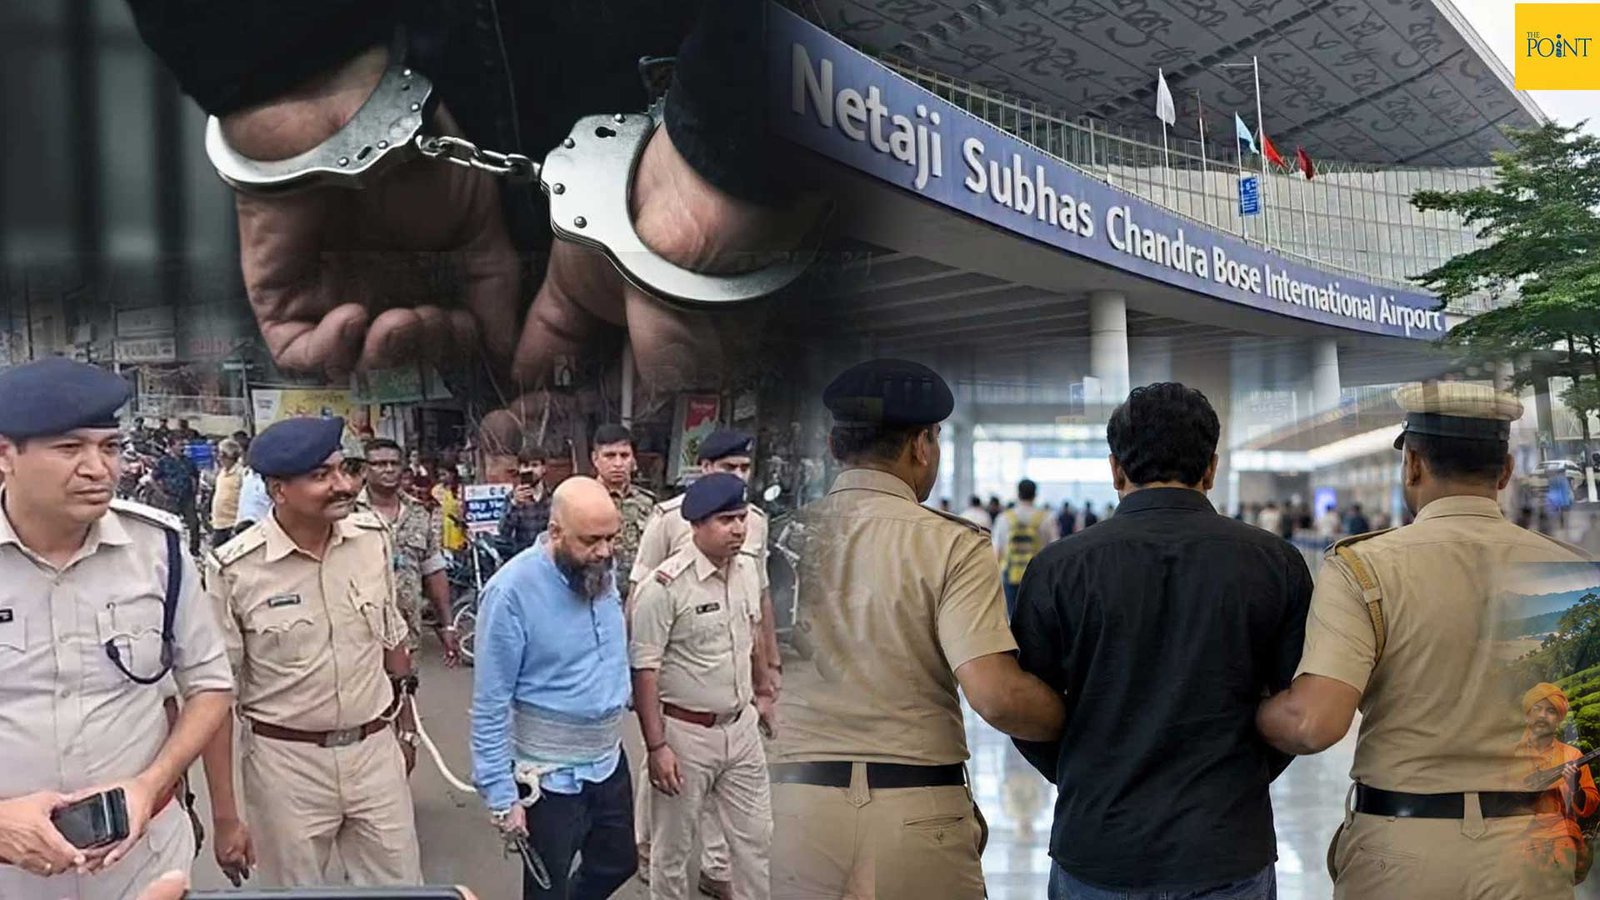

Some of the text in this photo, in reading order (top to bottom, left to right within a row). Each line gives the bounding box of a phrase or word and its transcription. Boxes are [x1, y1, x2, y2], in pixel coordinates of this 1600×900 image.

[791, 42, 1442, 335] Netaji Subhas Chandra Bose International Airport
